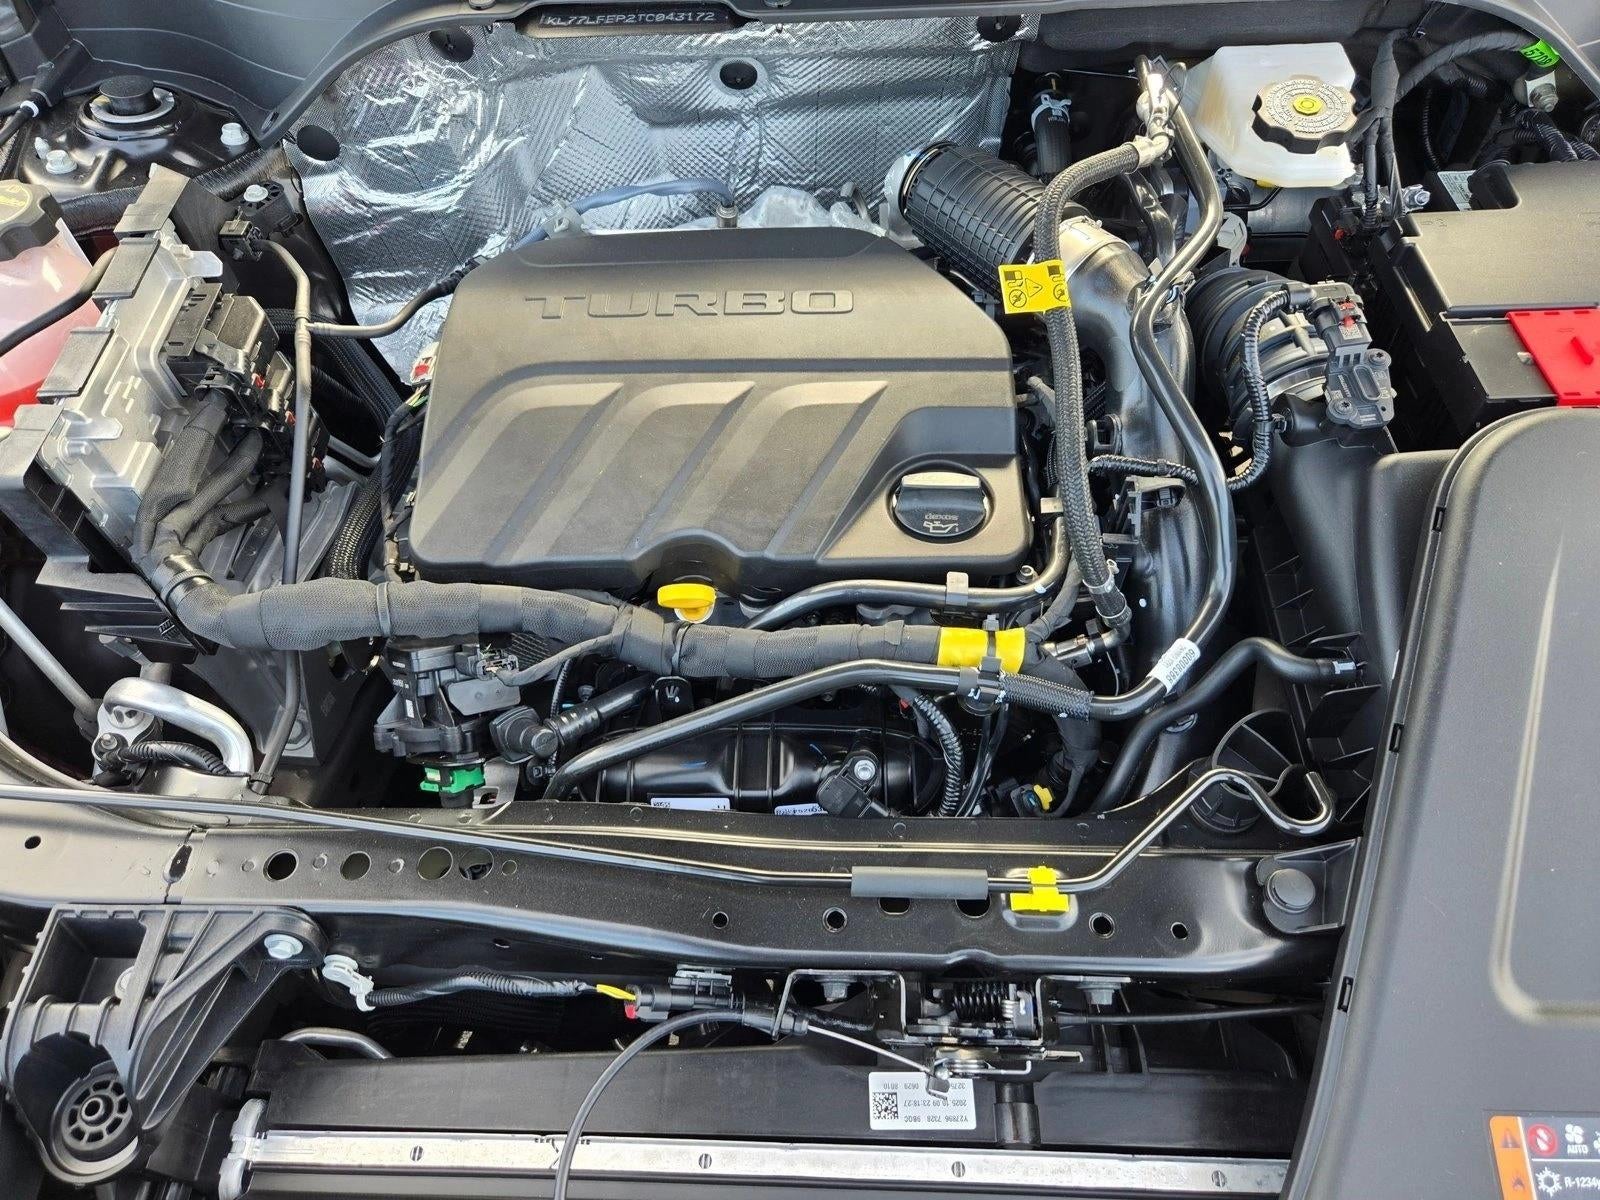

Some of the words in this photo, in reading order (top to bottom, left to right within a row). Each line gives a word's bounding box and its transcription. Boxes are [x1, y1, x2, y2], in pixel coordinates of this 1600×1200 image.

[546, 12, 716, 26] KL77LFEP2TC043172
[525, 290, 854, 319] TURBO
[1567, 1144, 1588, 1154] AUTO
